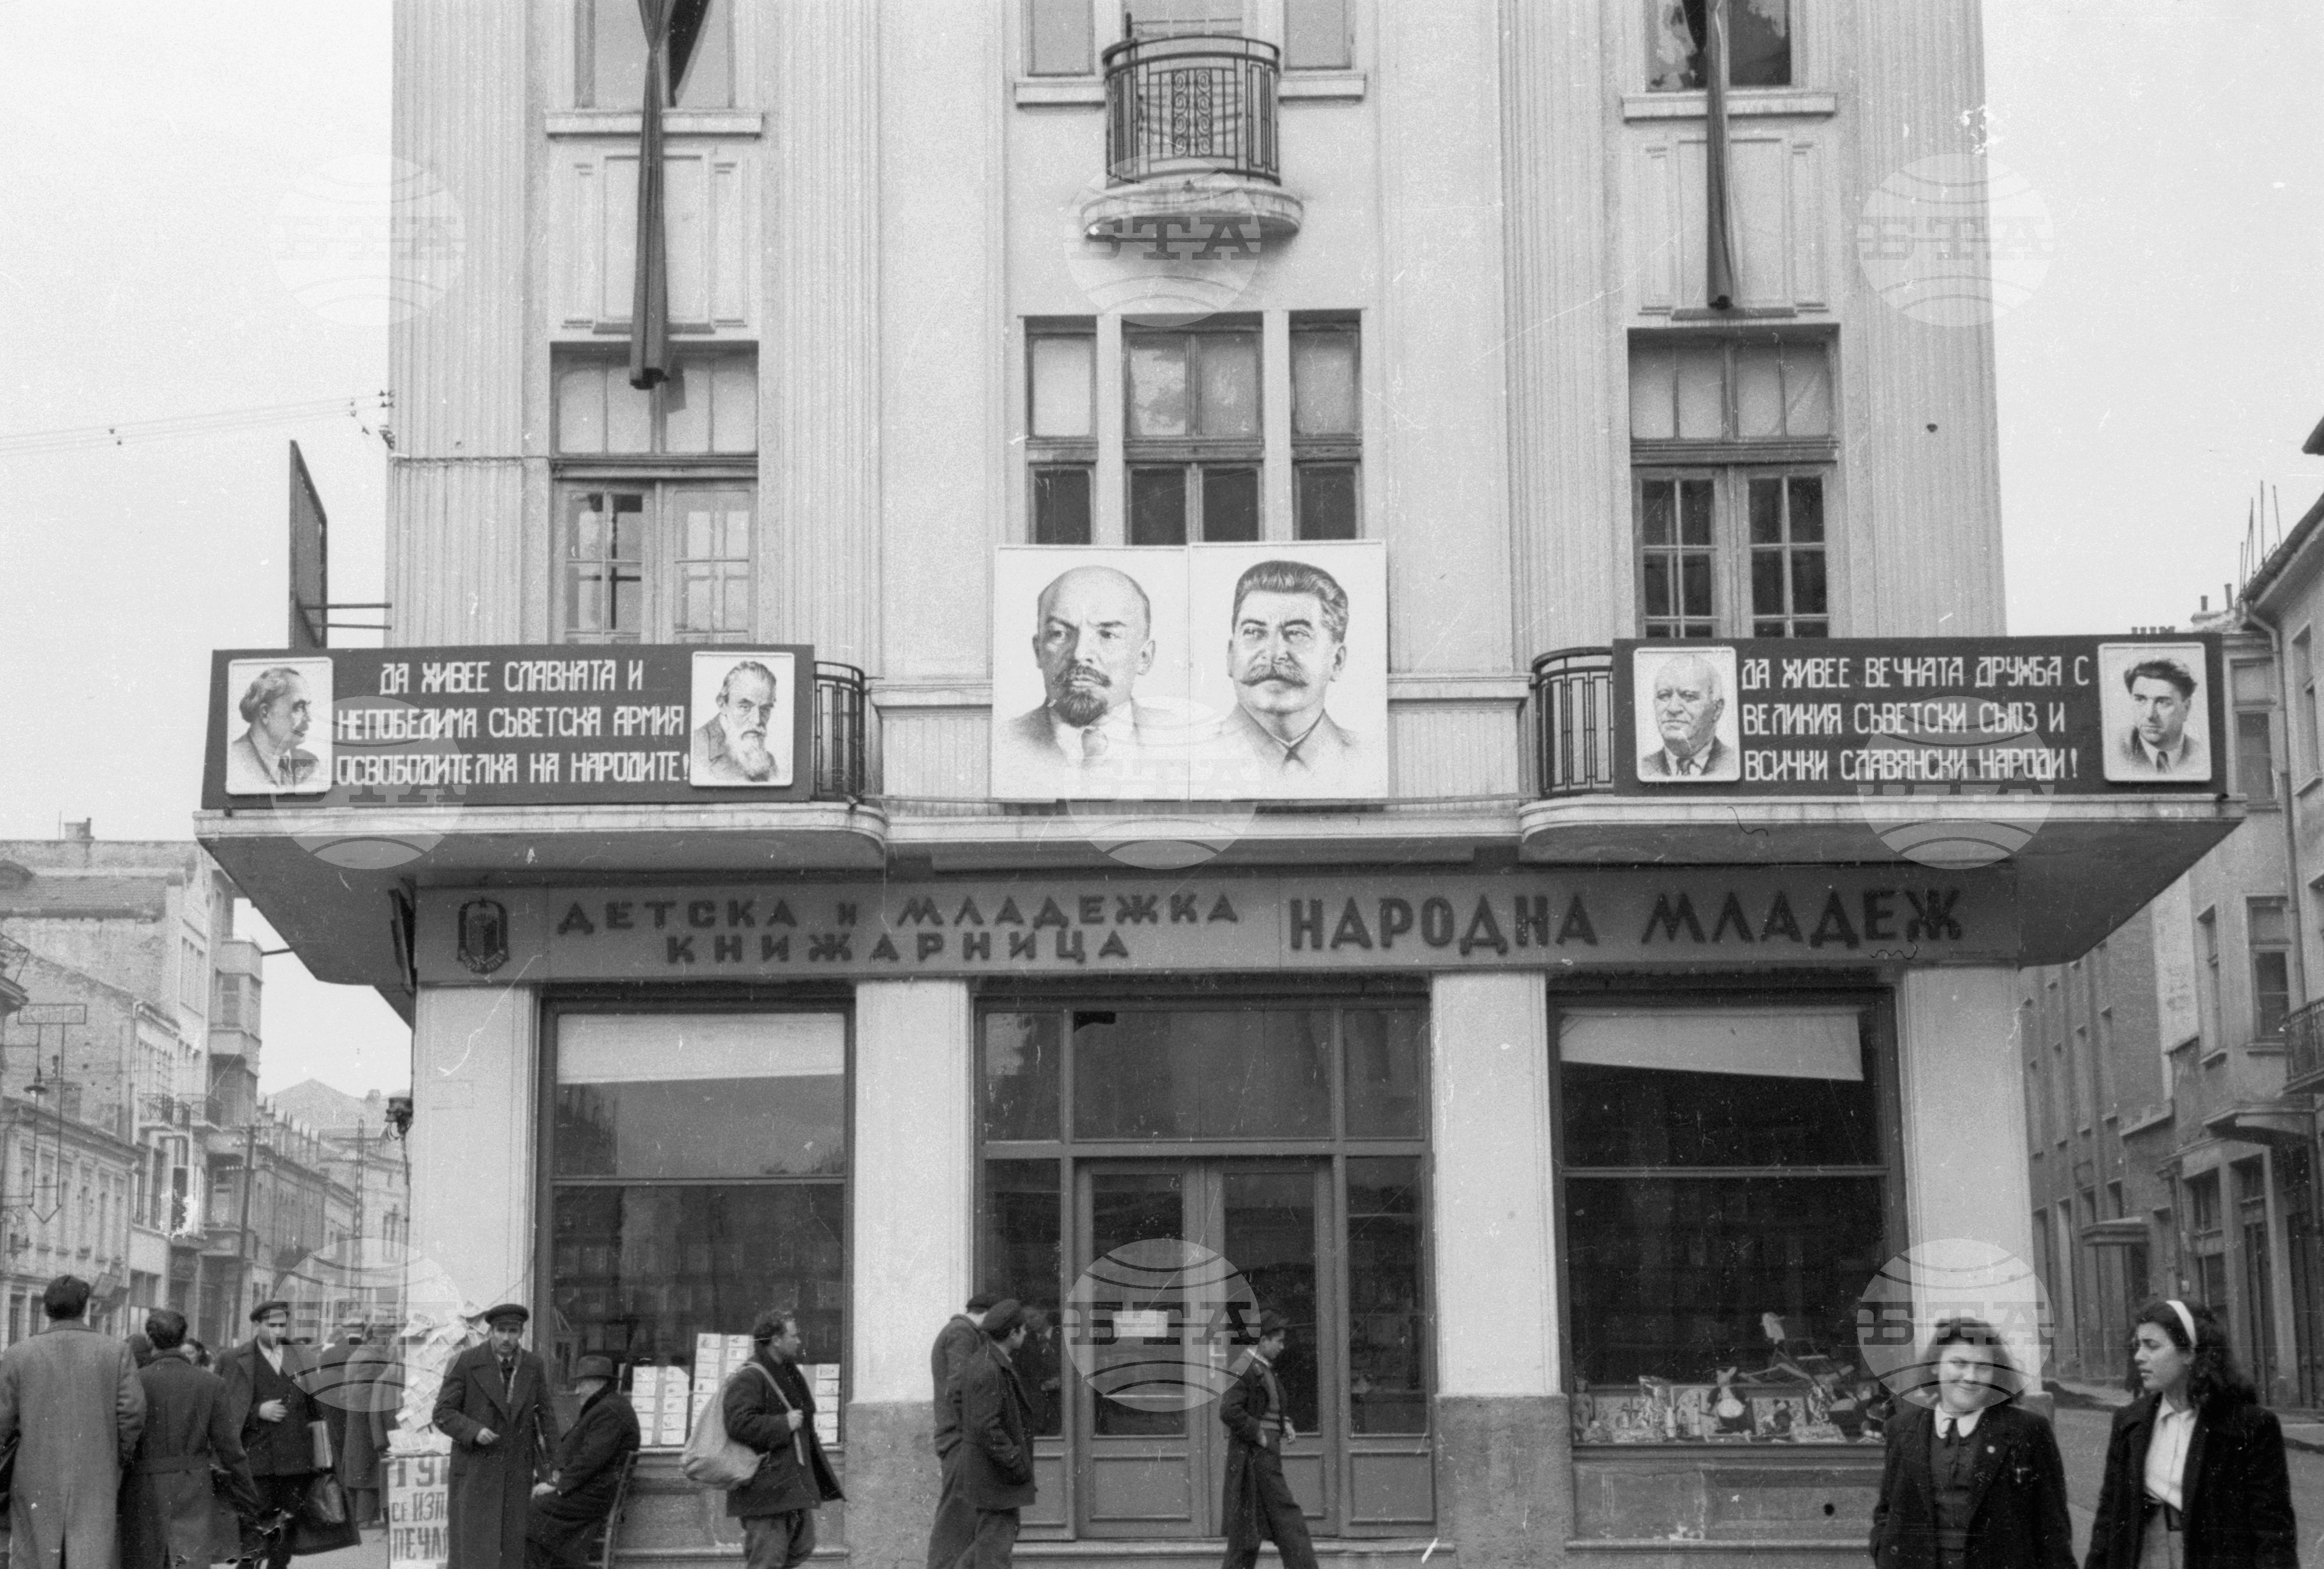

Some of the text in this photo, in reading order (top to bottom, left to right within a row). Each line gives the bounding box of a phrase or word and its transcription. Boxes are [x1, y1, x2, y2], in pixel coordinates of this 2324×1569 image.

[380, 660, 643, 695] ДА ЖИВЕЕ СЛАВНАТА И
[1742, 656, 2089, 690] ДА ЖИВЕЕ ВЕЧНАТА ДРУЖБА С
[338, 706, 684, 740] НЕПОБЕДИМА СЪВЕТСКА АРМИЯ
[1743, 702, 2064, 735] ВЕЛИКИЯ СЪВЕТСКИ СЪЮЗ И
[337, 752, 689, 785] ОСВОБОДИТЕЛКА НА НАРОДИТЕ!
[1745, 748, 2076, 781] ВСИЧКИ СЛАВЯНСКИ НАРОДИ!
[556, 898, 797, 935] ДЕТСКА
[898, 893, 1238, 931] МЛАДЕЖКА
[1289, 888, 1963, 956] НАРОДНА МЛАДЕЖ
[666, 931, 1129, 964] КНИЖАРНИЦА
